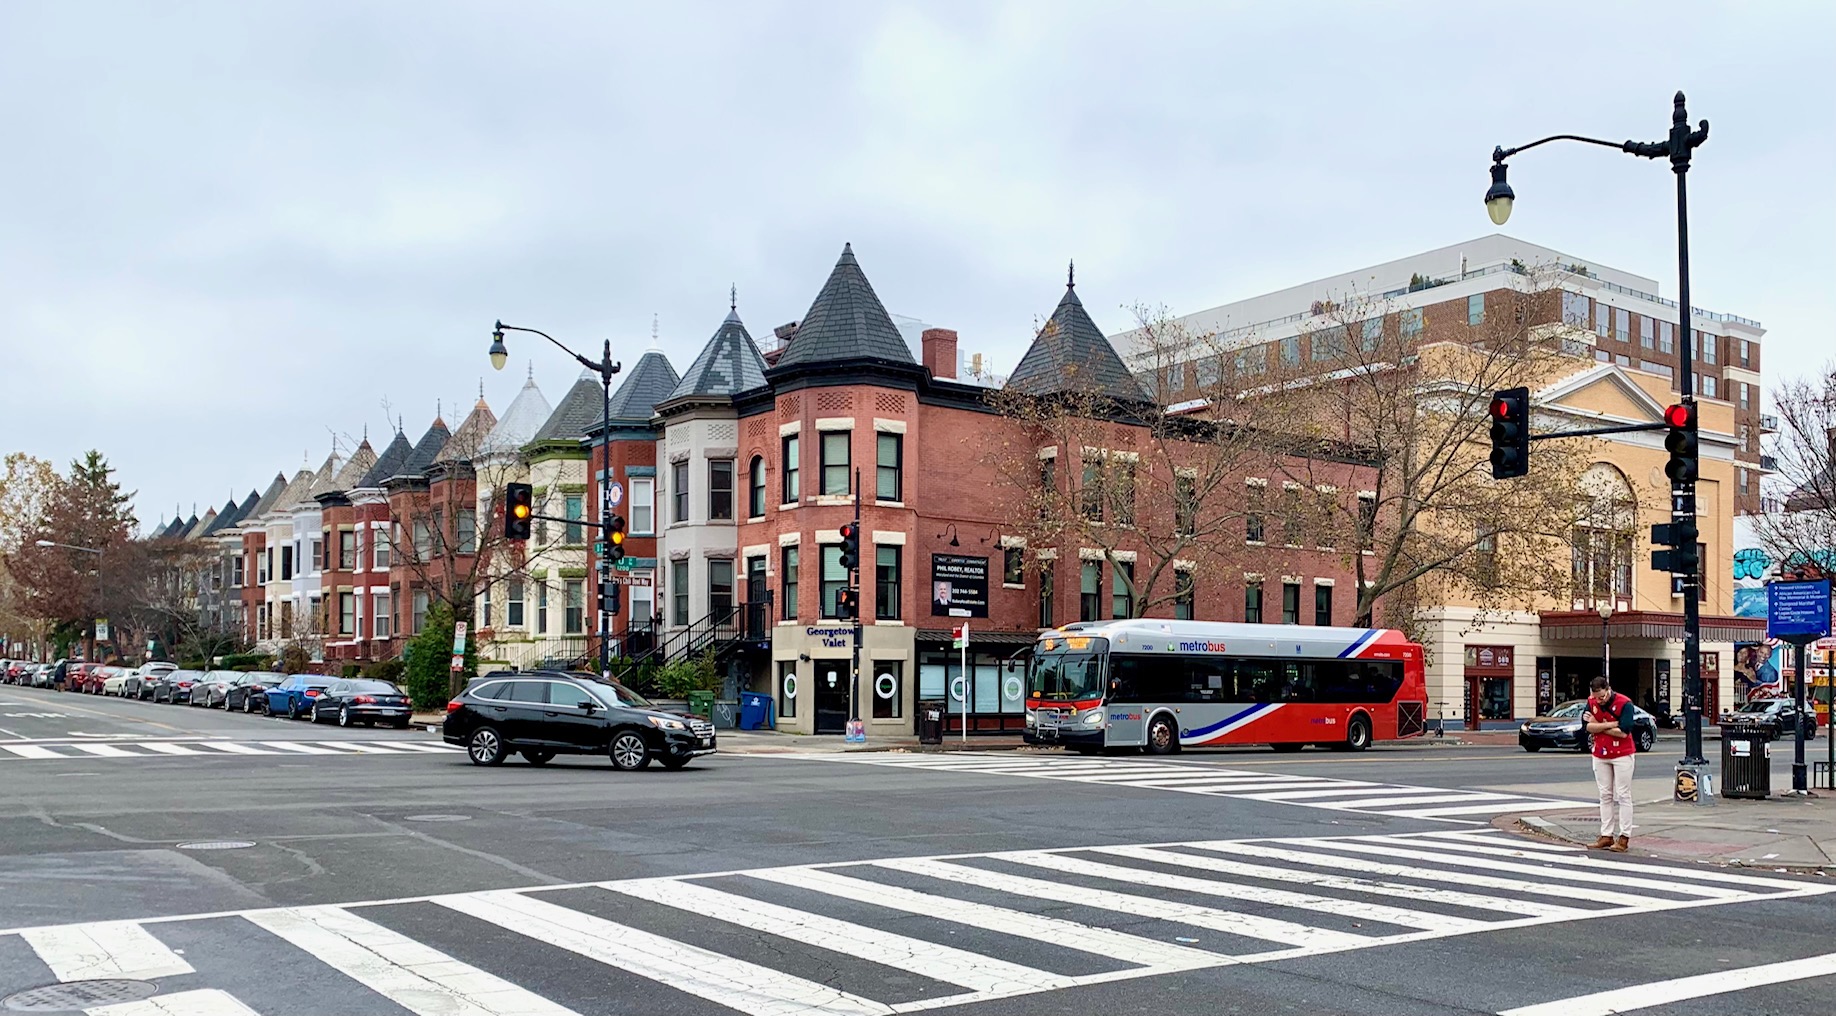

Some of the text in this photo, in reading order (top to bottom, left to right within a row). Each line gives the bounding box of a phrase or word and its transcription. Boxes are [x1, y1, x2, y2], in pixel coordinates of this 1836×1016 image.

[806, 627, 855, 637] Georgetow
[822, 638, 846, 647] Valet
[1180, 641, 1226, 652] metrobus
